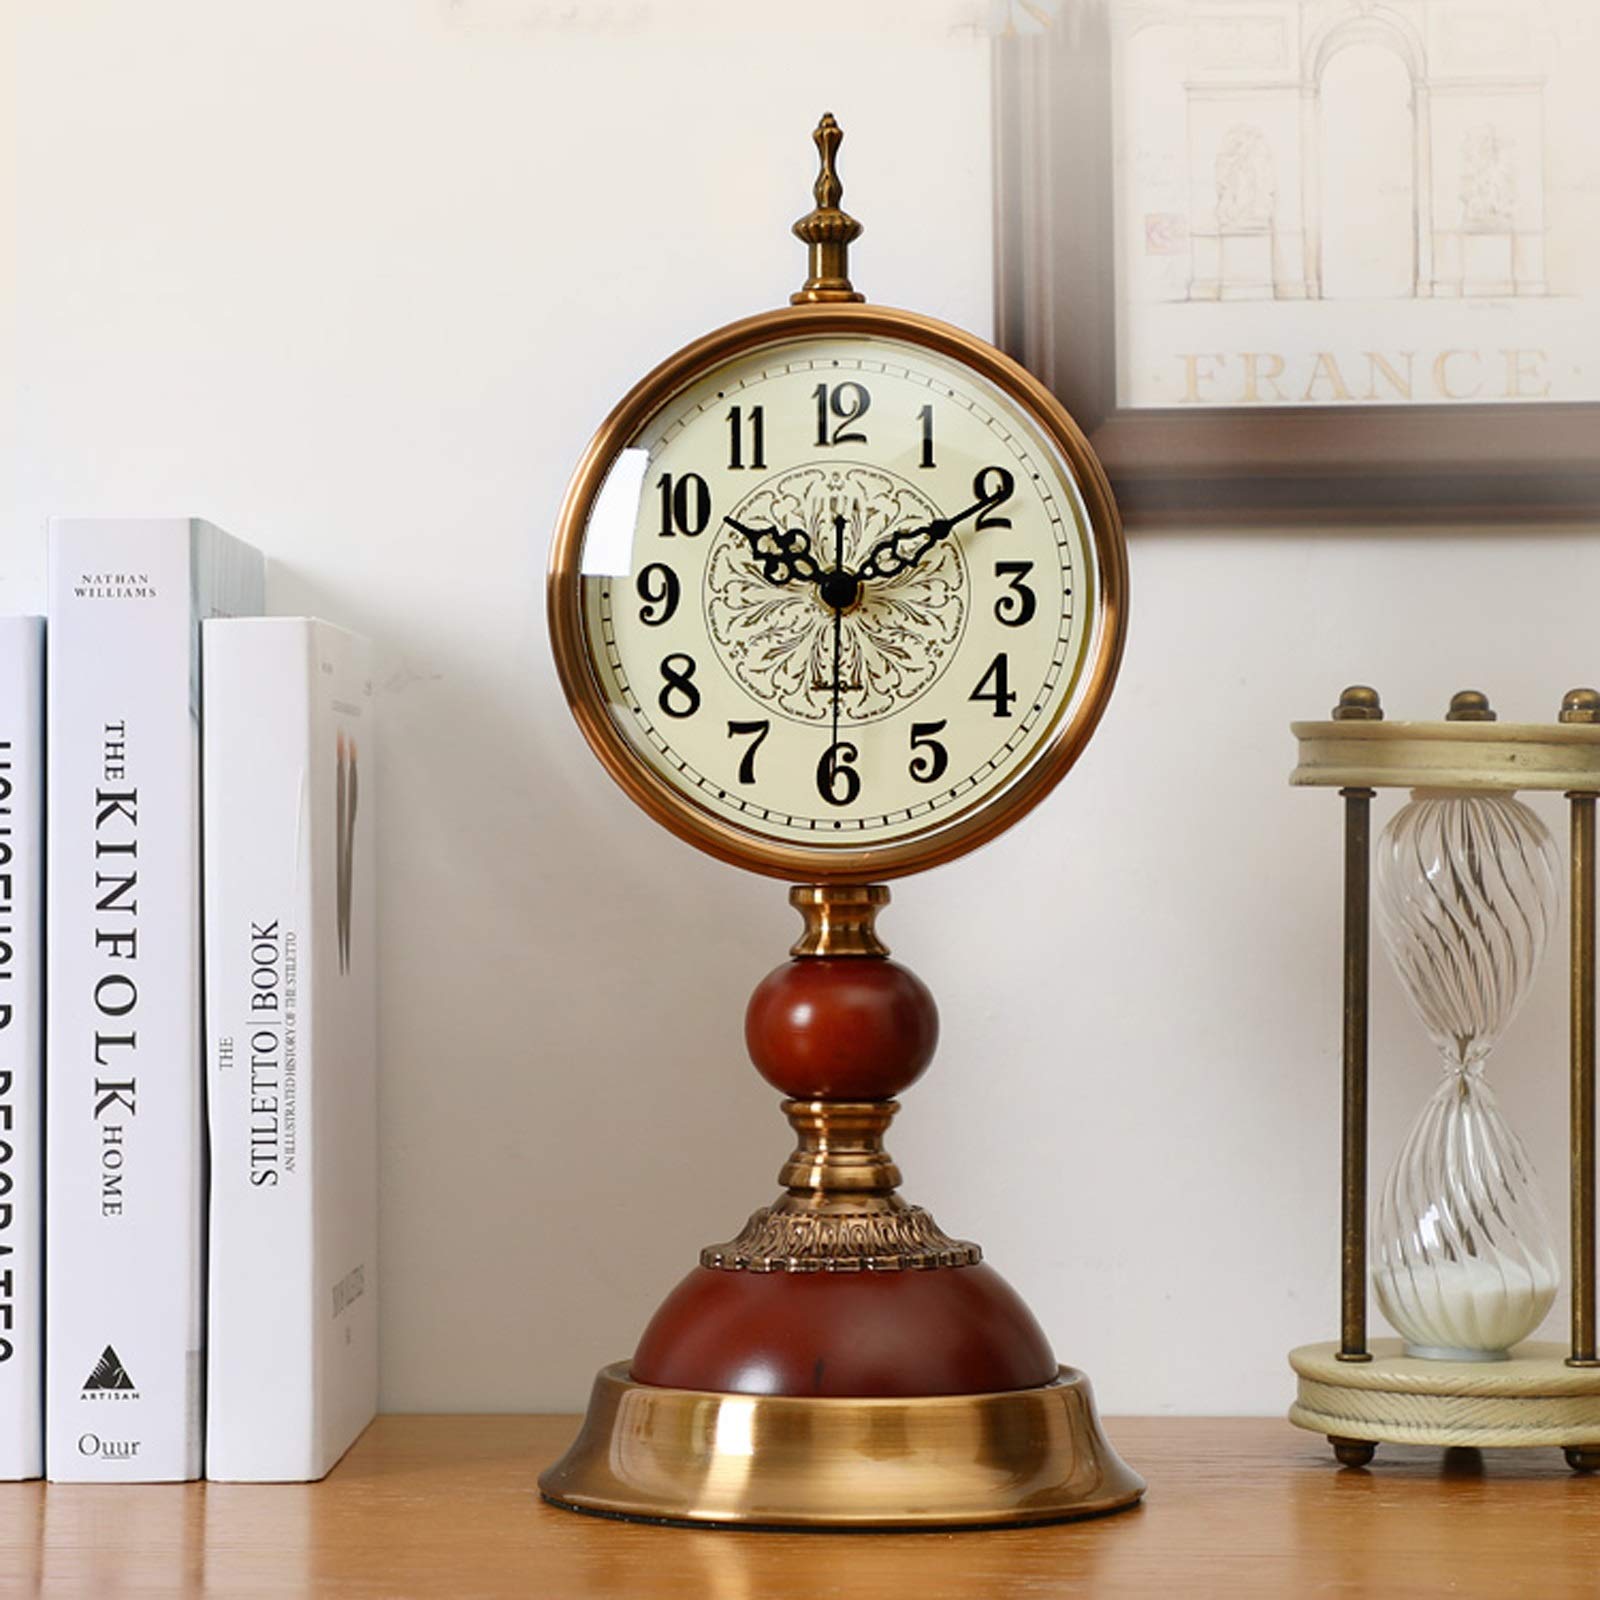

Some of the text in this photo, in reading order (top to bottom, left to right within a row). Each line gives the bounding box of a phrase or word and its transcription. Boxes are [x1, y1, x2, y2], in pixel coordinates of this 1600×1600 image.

[1175, 348, 1553, 403] FRANCE
[725, 405, 768, 470] 11
[811, 381, 871, 447] 12
[916, 404, 936, 469] 1
[656, 472, 713, 538] 10
[972, 466, 1015, 532] 2
[74, 587, 157, 599] WILLIAMS
[82, 574, 149, 584] NATHAN
[636, 562, 680, 627] 9
[994, 561, 1036, 627] 3
[658, 652, 701, 719] 8
[969, 652, 1017, 718] 4
[727, 719, 770, 785] 7
[816, 742, 861, 807] 6
[908, 718, 949, 784] 5
[94, 720, 138, 1217] THE KINFOLK HOME
[218, 1036, 234, 1071] THE
[250, 919, 279, 1187] STILETTO BOOK
[80, 1392, 140, 1401] ARTISAN
[78, 1433, 141, 1459] Ouur
